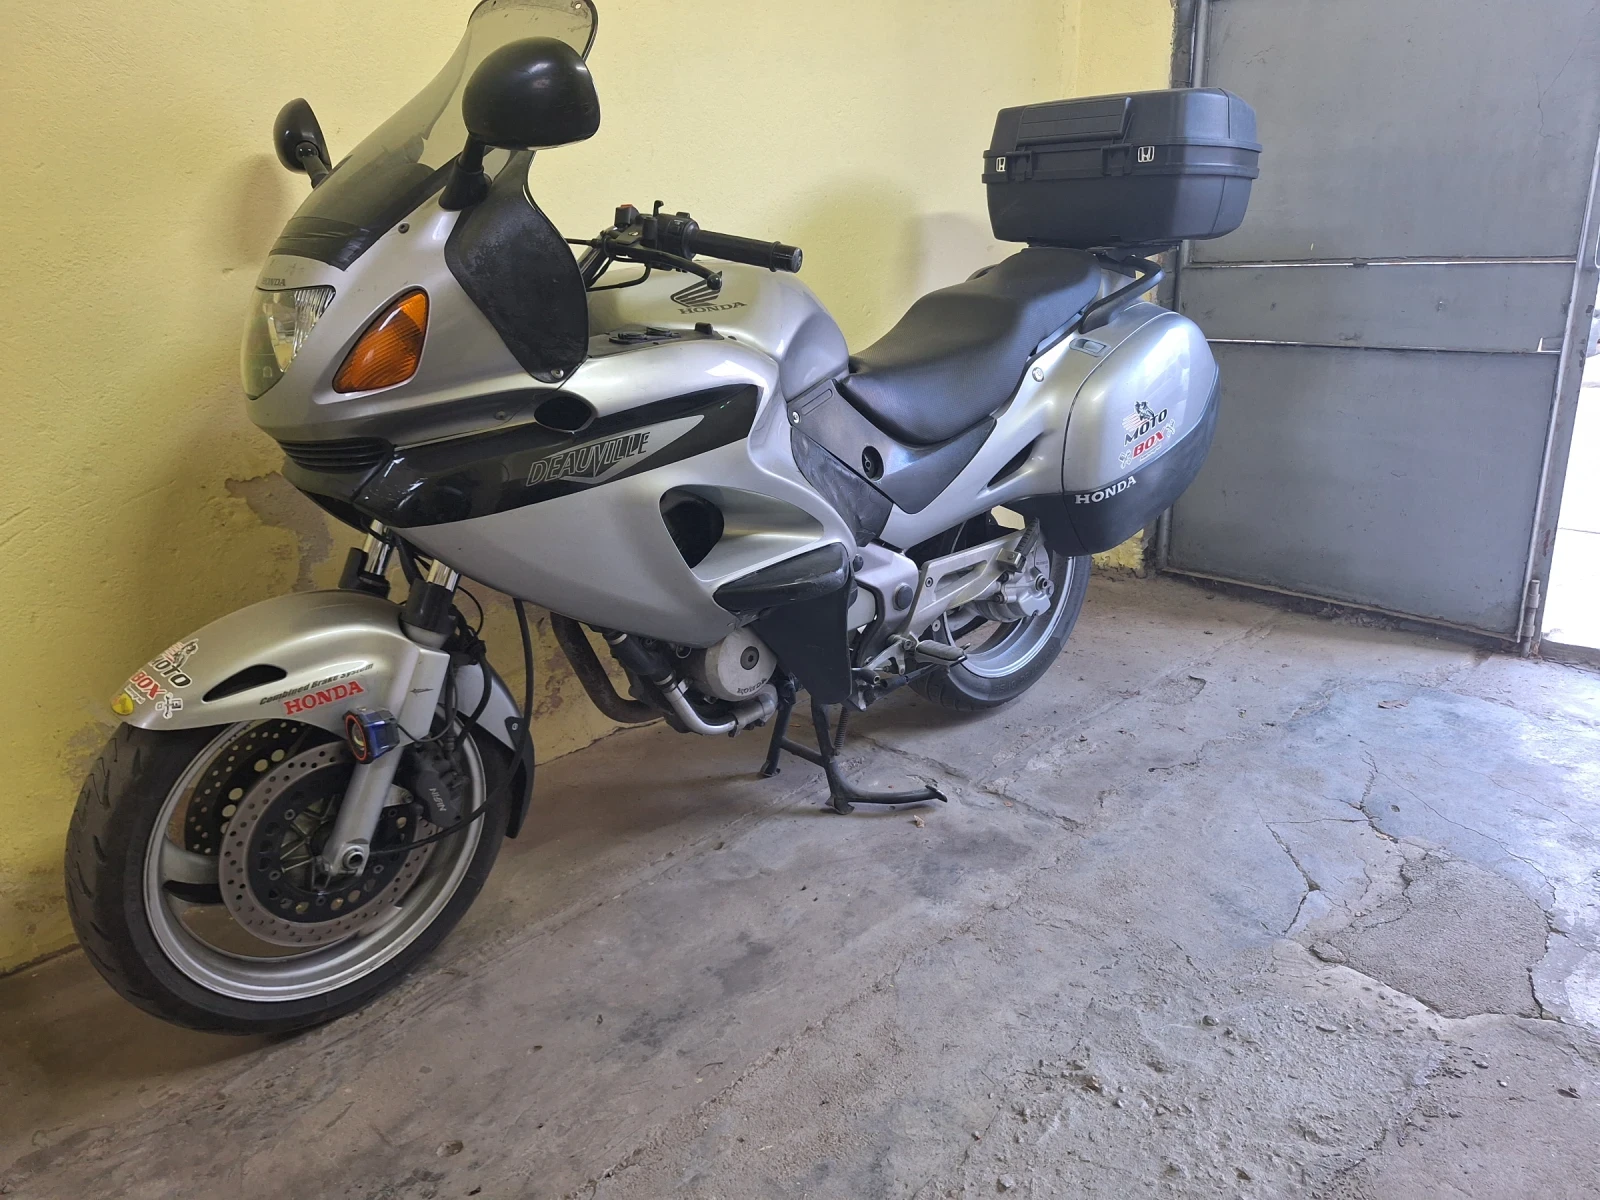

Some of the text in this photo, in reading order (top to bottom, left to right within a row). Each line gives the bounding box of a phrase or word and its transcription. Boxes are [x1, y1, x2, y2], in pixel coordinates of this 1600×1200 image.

[678, 301, 747, 314] HONDA
[1124, 408, 1168, 447] MOTO
[1132, 427, 1166, 458] BOX
[526, 431, 650, 487] DEAUVILLE
[1075, 475, 1136, 504] HONDA
[130, 670, 167, 700] BOX
[259, 684, 311, 706] Combined
[311, 675, 339, 690] Brake
[283, 680, 365, 715] HONDA
